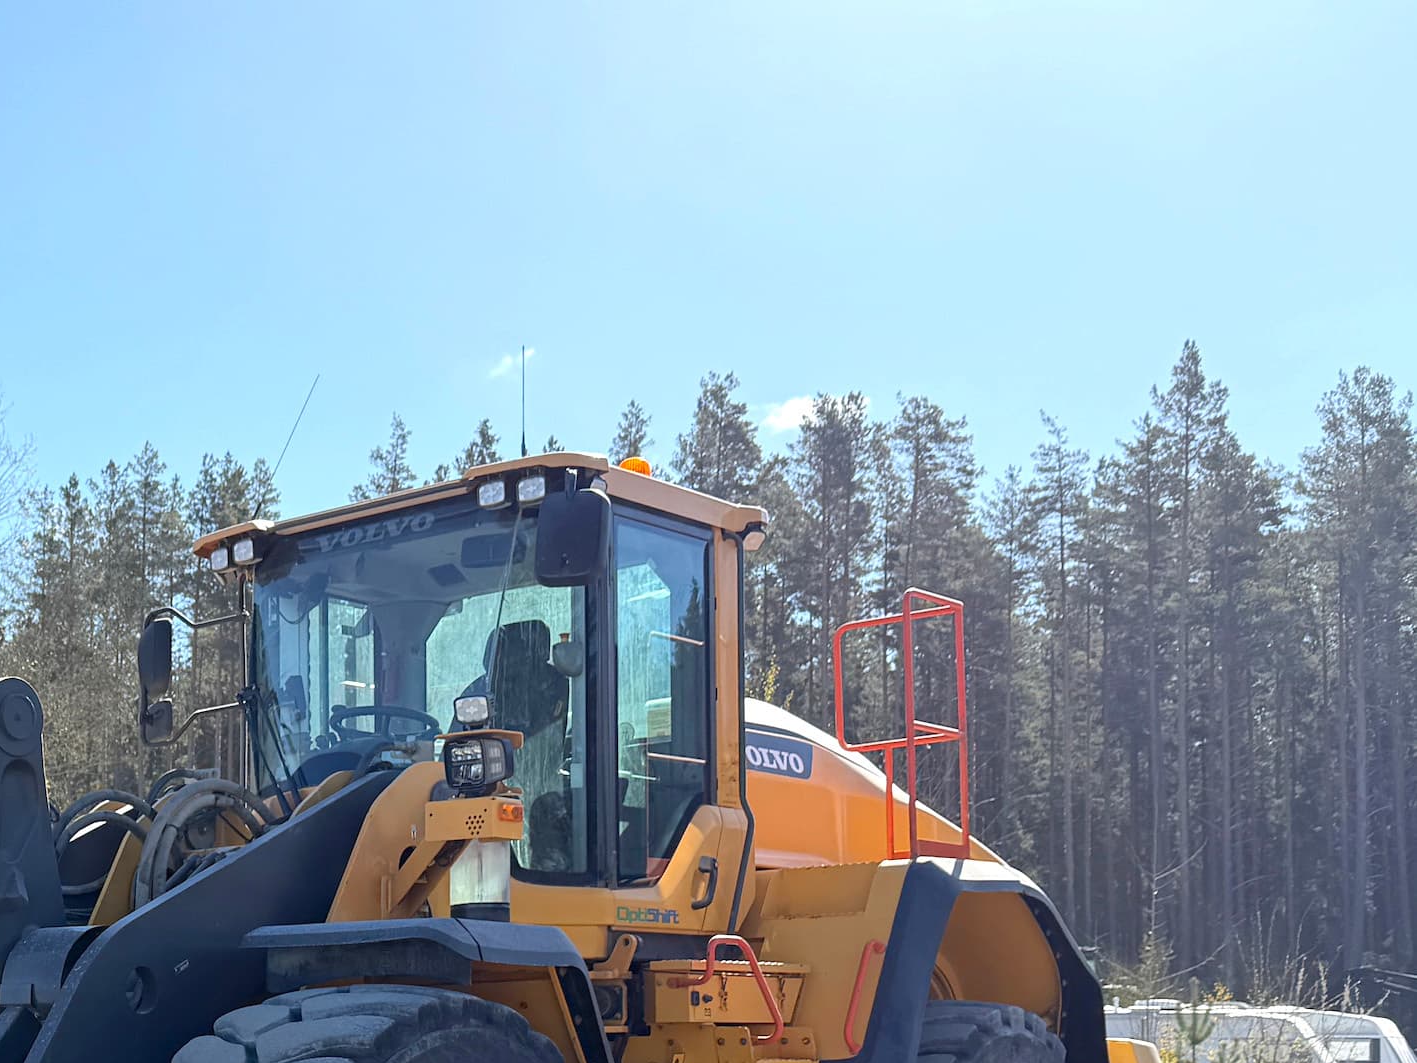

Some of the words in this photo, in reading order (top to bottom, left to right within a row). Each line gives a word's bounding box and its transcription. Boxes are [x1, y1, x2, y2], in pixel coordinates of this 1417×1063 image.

[316, 512, 435, 552] VOLVO
[745, 745, 804, 774] OLVO
[617, 906, 679, 923] OptiShift
